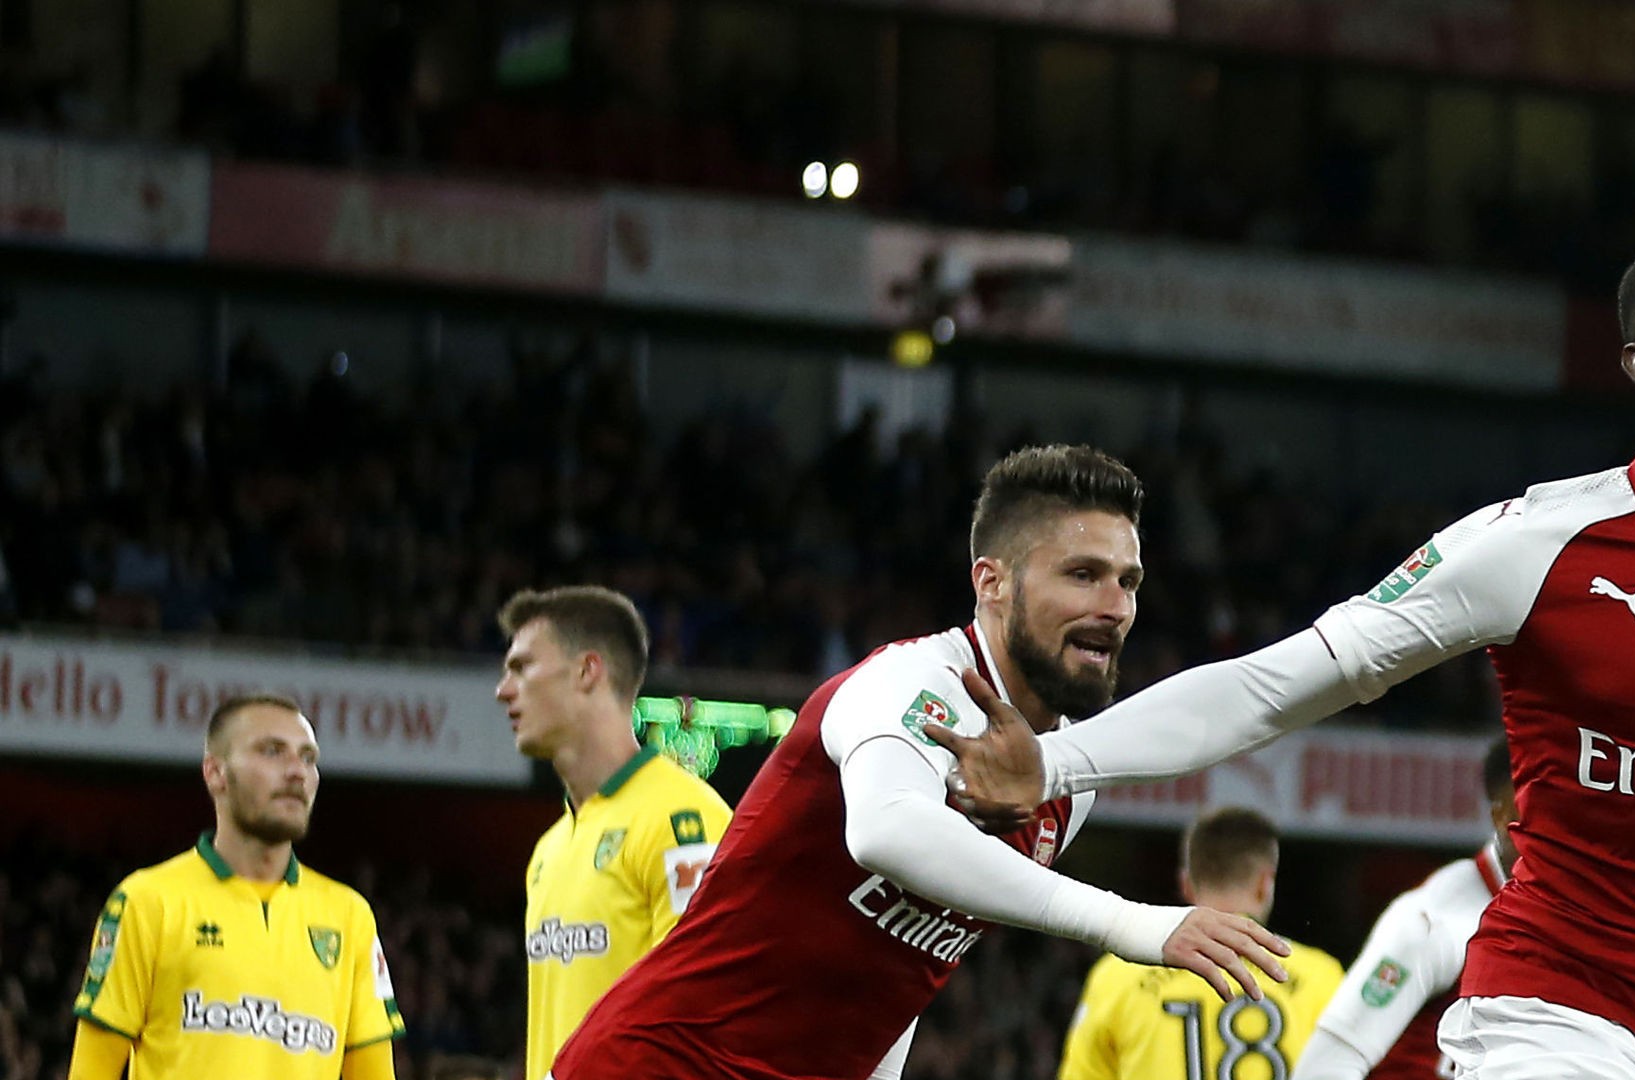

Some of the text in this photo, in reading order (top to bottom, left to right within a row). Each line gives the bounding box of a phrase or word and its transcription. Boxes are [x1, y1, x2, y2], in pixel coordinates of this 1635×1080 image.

[150, 664, 458, 751] Torrow.
[849, 873, 983, 963] Emirat
[183, 990, 339, 1056] LeoVegas
